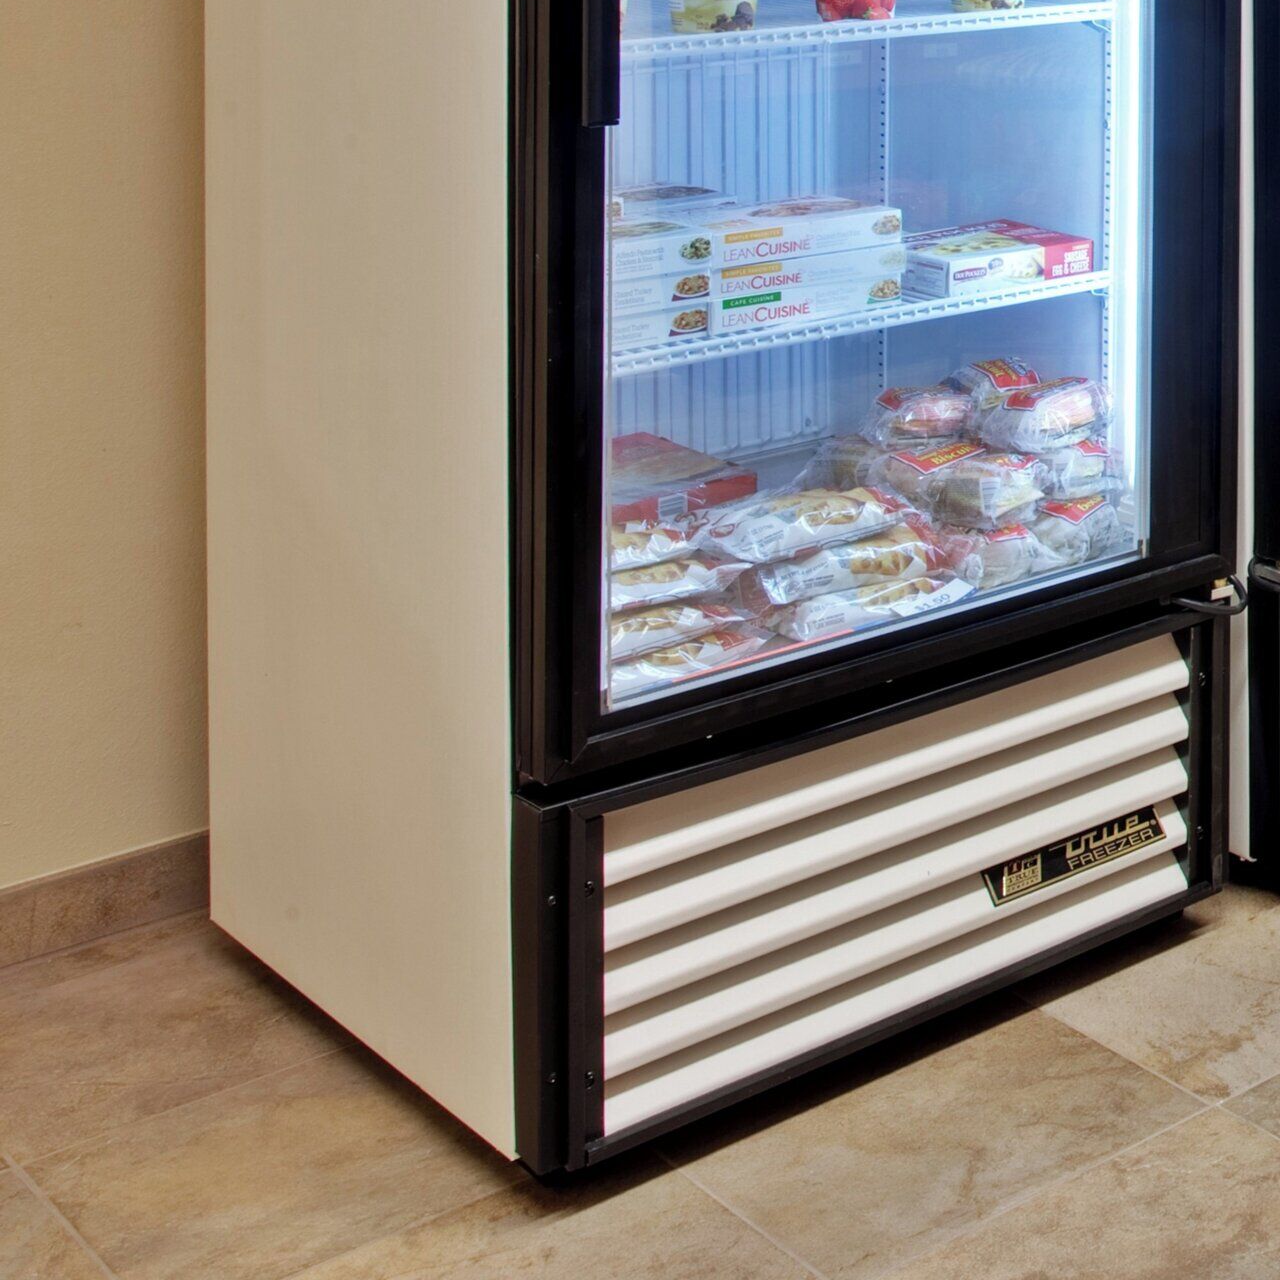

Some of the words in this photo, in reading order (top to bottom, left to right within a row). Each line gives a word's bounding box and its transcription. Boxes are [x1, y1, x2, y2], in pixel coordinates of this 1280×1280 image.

[723, 248, 756, 263] LEAN
[755, 239, 811, 258] CUISINE
[1052, 264, 1063, 276] EGG
[1063, 264, 1069, 275] &
[1069, 261, 1091, 274] CHEESE
[720, 281, 751, 294] LEAN
[750, 273, 803, 290] CUISINE
[748, 294, 774, 304] CUISINE
[722, 312, 755, 328] LEAN
[754, 302, 811, 322] CUISINE
[930, 445, 976, 466] Biscuit
[914, 593, 951, 611] $1.50
[1066, 827, 1155, 870] FREEZER
